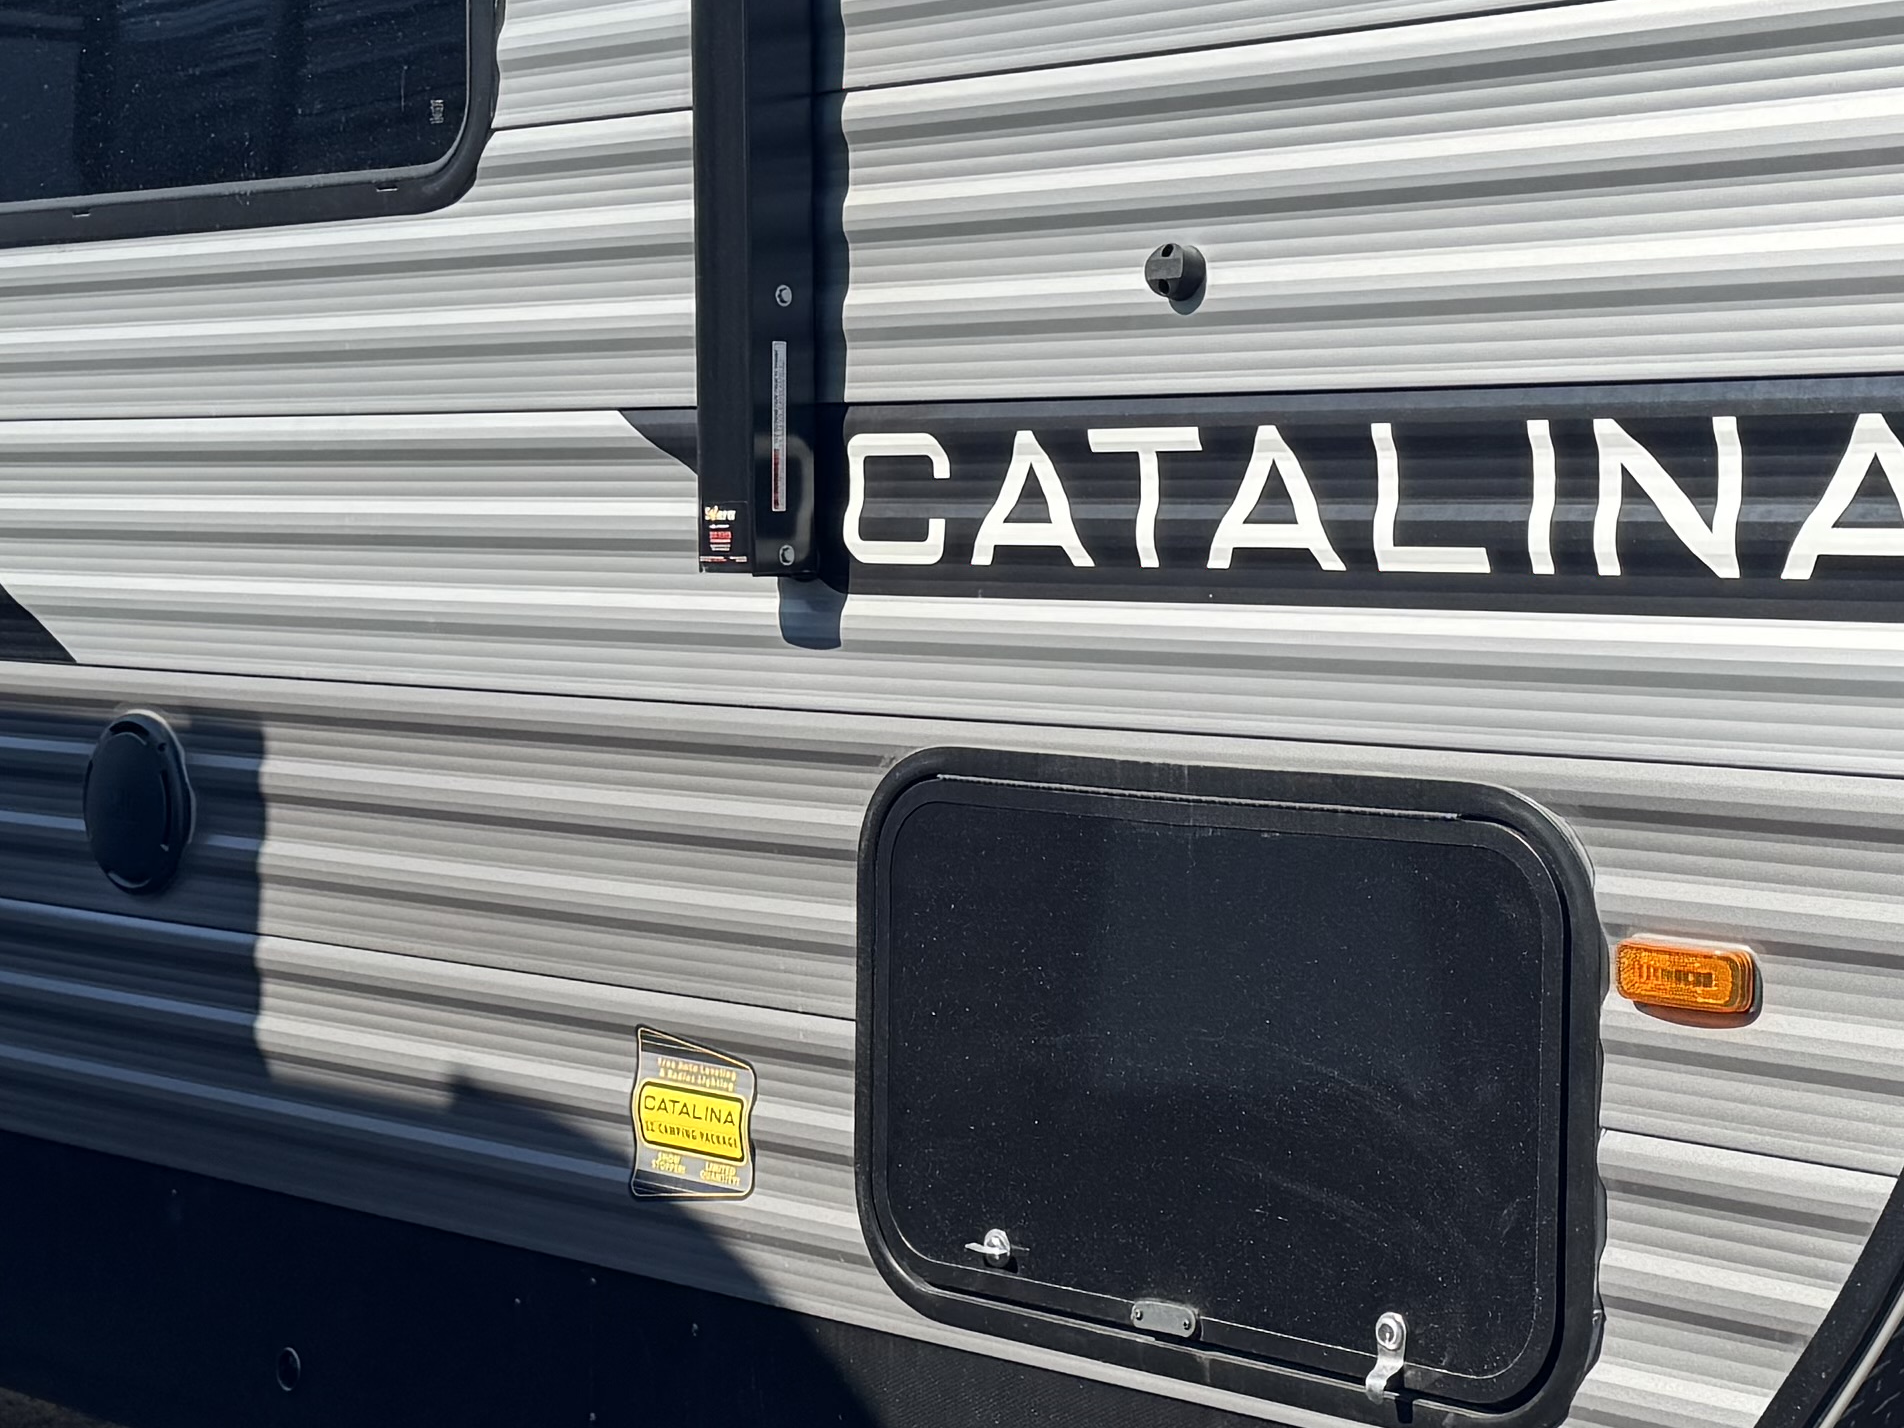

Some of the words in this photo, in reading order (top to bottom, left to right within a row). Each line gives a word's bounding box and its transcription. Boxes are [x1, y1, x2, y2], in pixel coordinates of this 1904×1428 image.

[644, 1095, 736, 1126] CATALINA
[658, 1123, 697, 1140] CAMPING
[700, 1130, 738, 1148] PACKAGE
